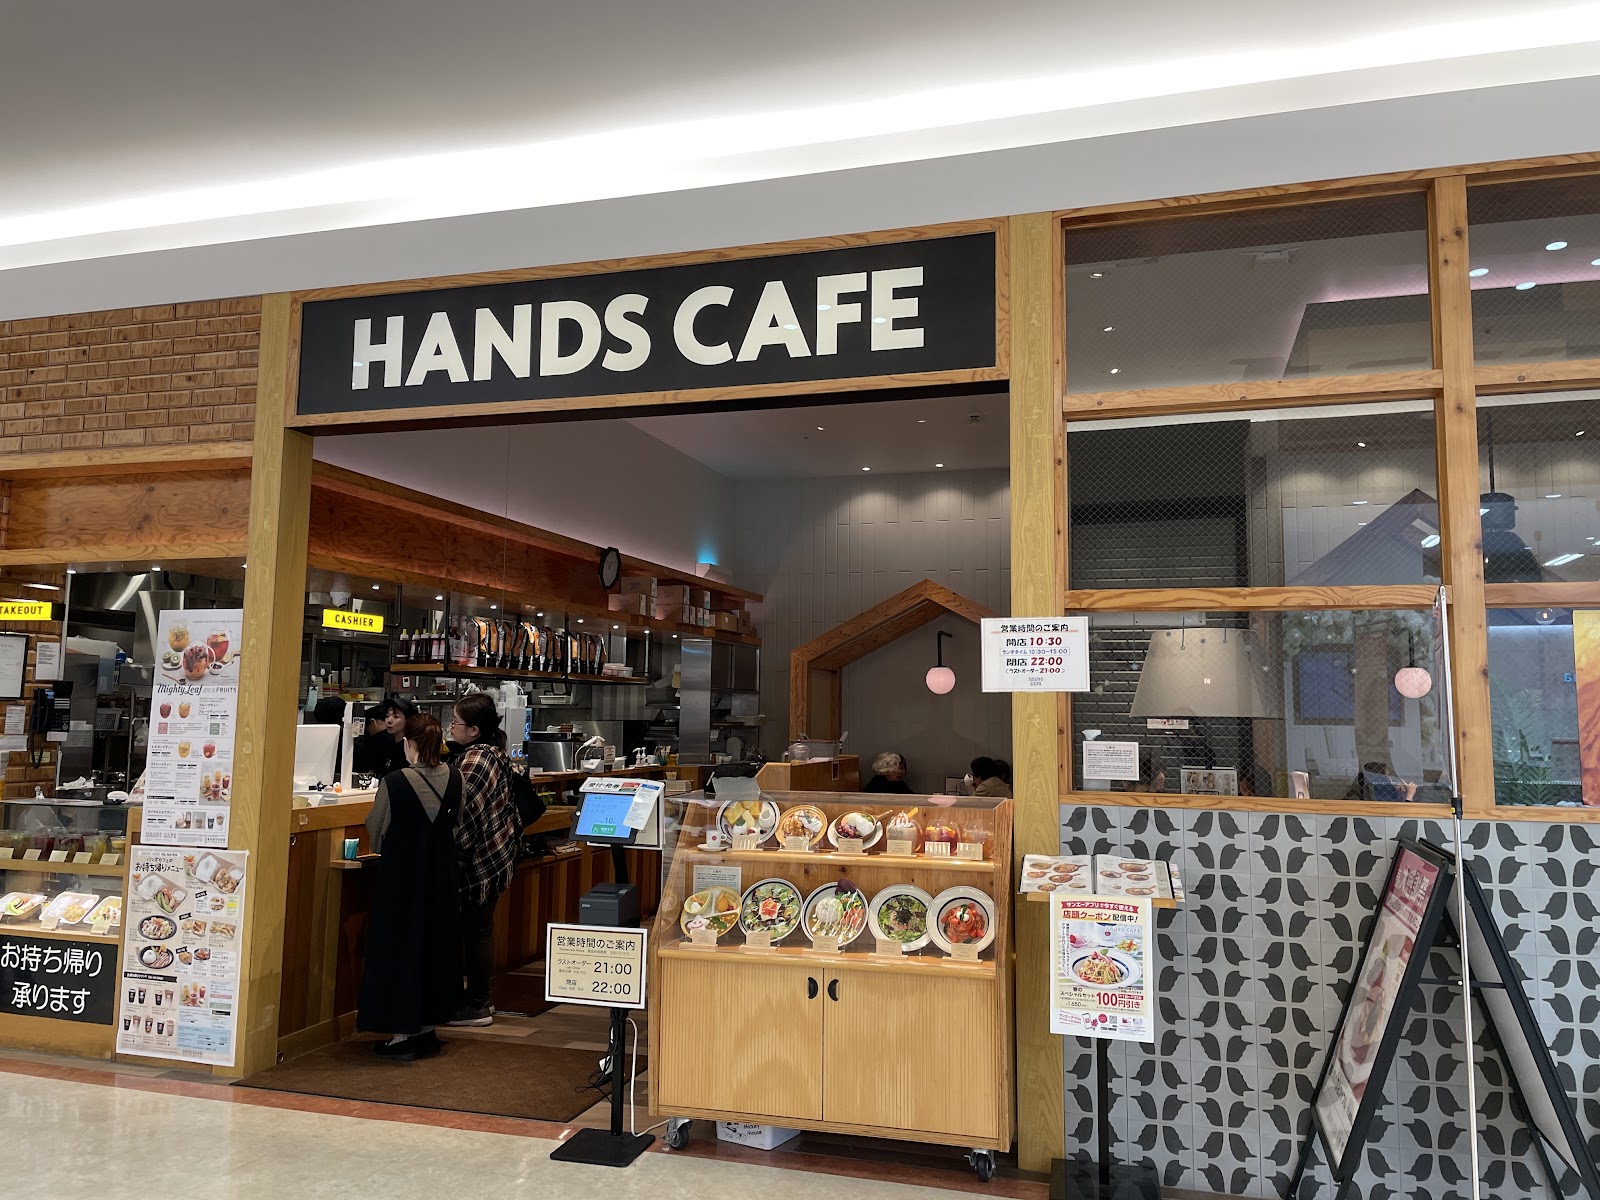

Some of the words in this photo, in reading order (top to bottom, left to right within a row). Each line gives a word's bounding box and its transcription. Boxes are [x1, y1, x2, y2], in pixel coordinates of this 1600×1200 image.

[351, 293, 651, 390] HANDS
[673, 266, 924, 365] CAFE
[0, 605, 43, 615] TAKEOUT
[335, 614, 374, 627] CASHIER
[1000, 624, 1069, 633] 営業時間のご案内
[1006, 638, 1027, 646] 開店
[1029, 637, 1062, 646] 10:30
[1006, 658, 1028, 667] 閉店
[1030, 657, 1063, 666] 22:00
[157, 682, 185, 696] Mighty
[184, 683, 204, 696] Leaf
[135, 862, 184, 872] お持ち帰りメニュー
[1066, 902, 1134, 911] サンエーアプリで今すぐ使える
[557, 936, 636, 951] 営業時間のご案内
[1, 942, 103, 977] お持ち帰り
[594, 962, 632, 975] 21:00
[592, 981, 631, 995] 22:00
[11, 981, 91, 1015] 承ります
[1060, 991, 1096, 999] スペシャルセット
[1096, 992, 1118, 1007] 100
[1118, 1000, 1141, 1009] 円引き
